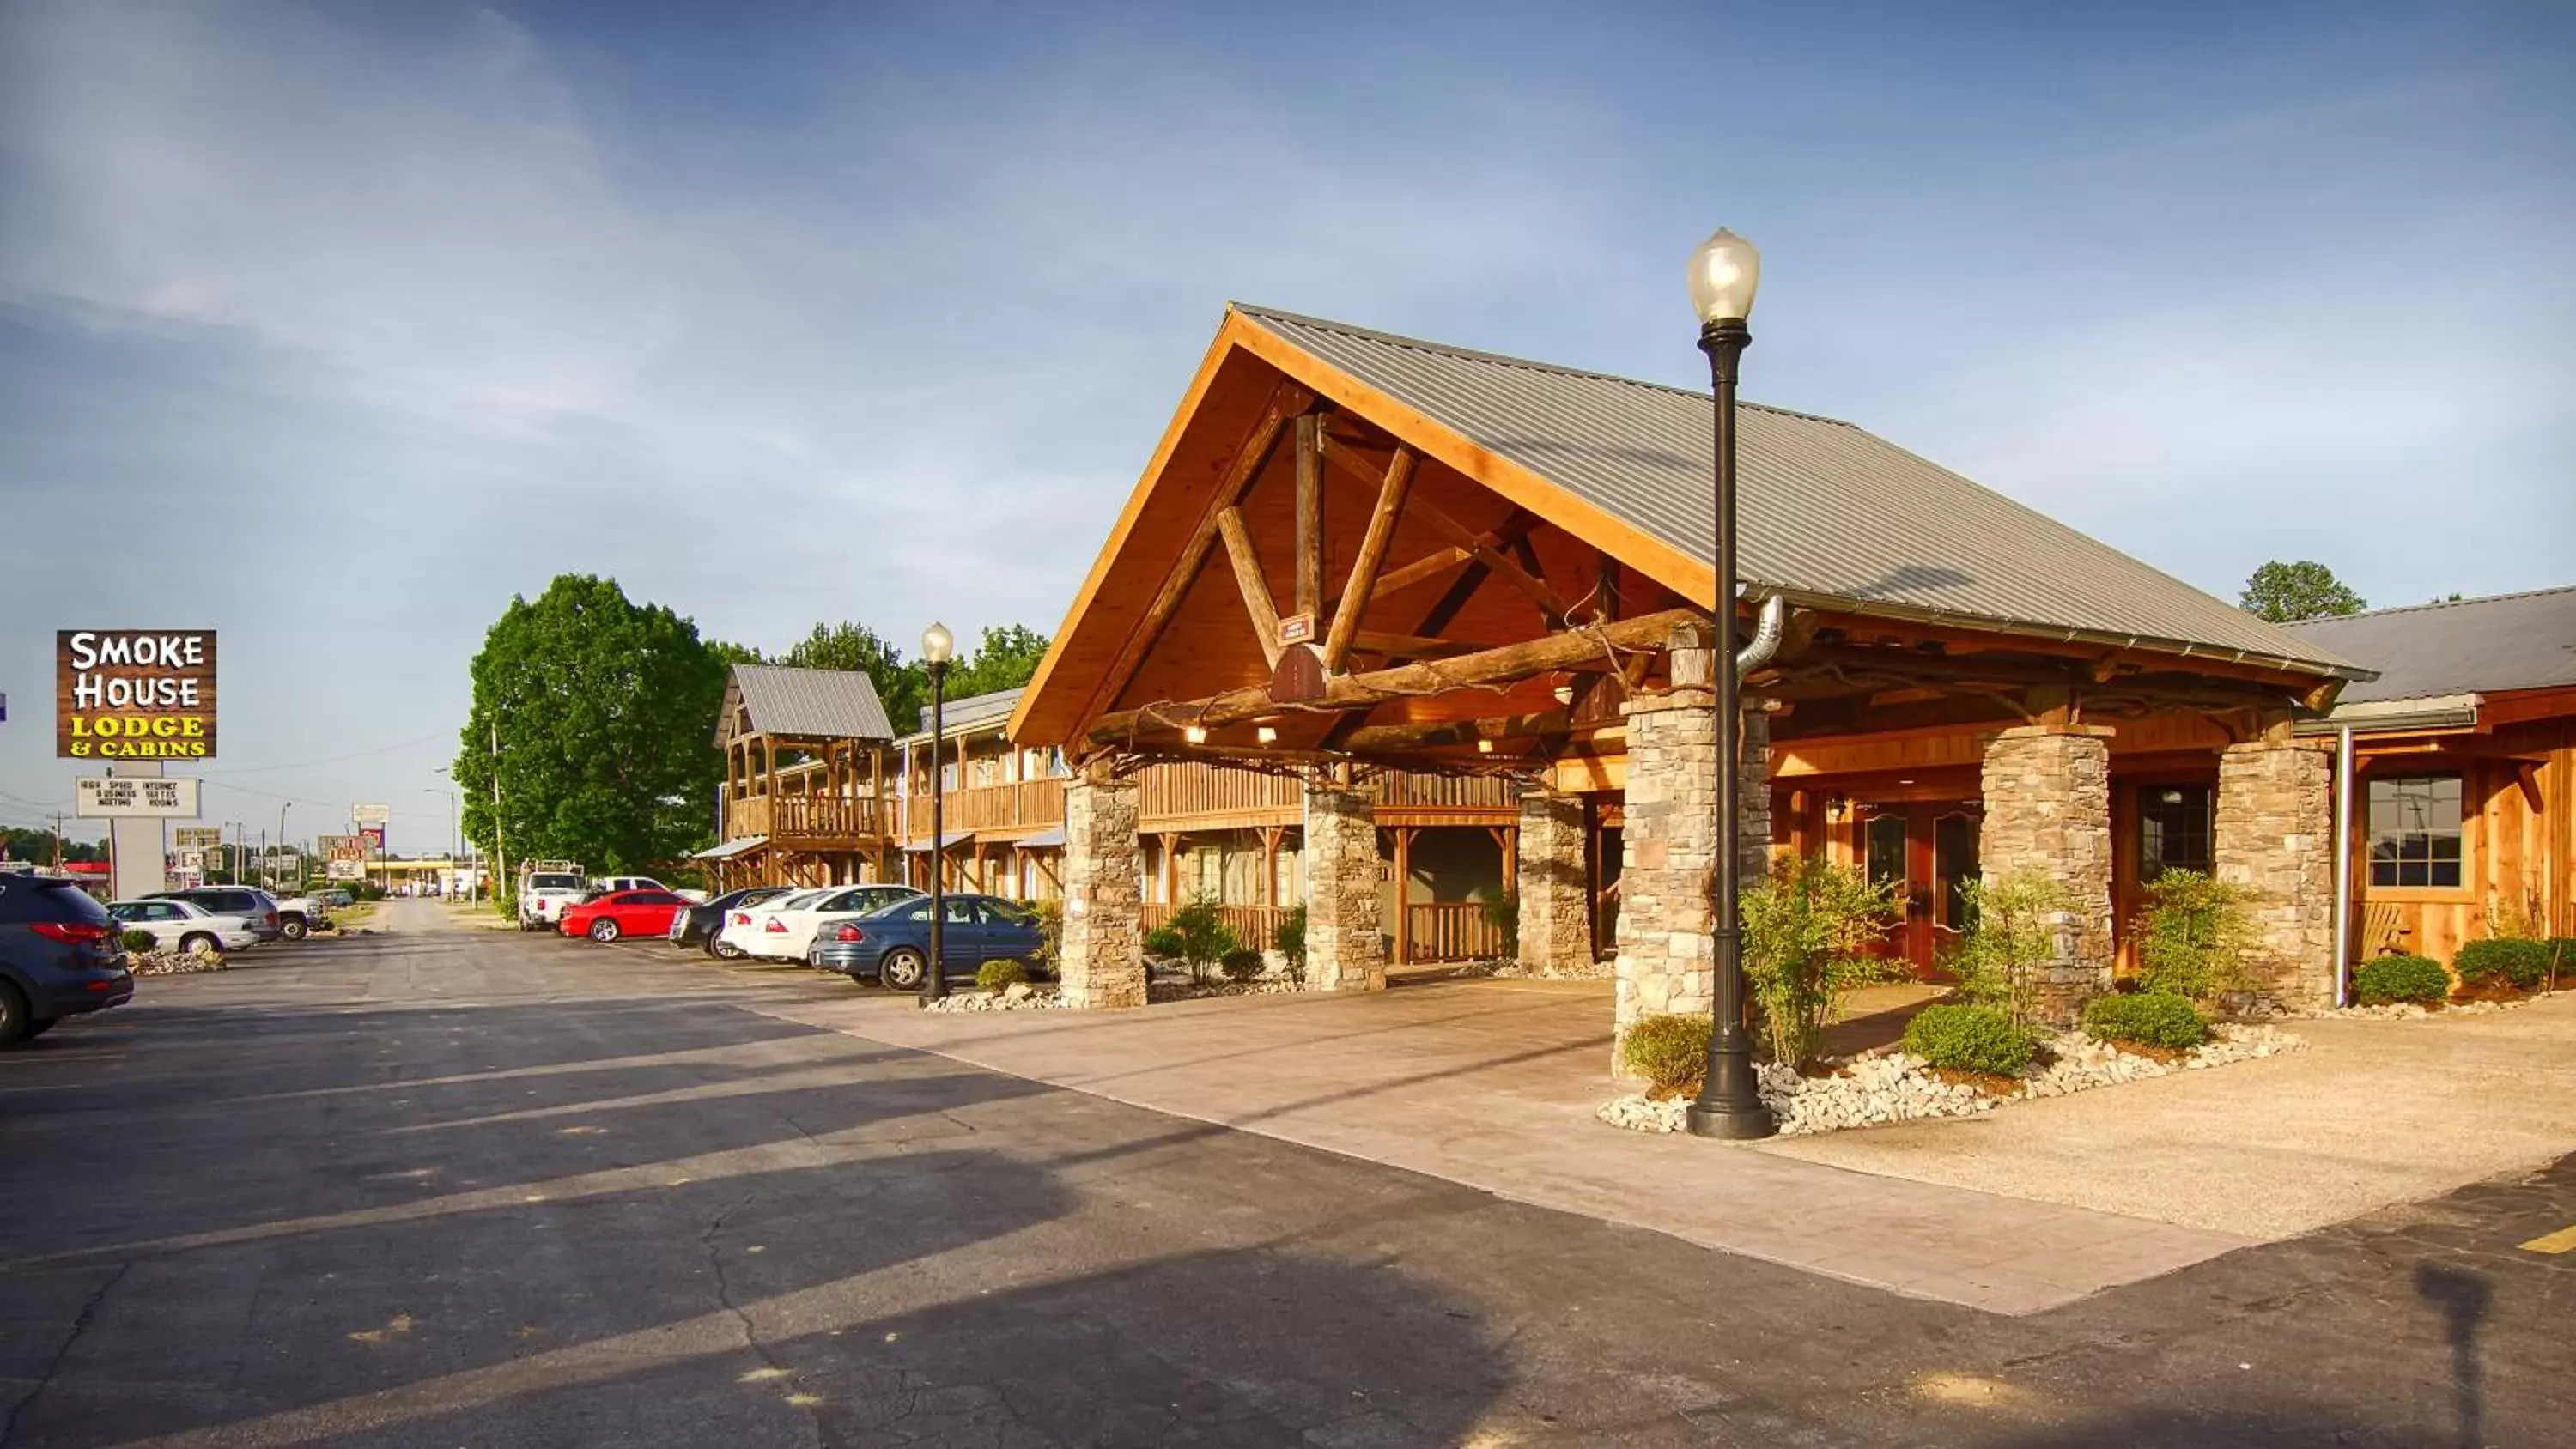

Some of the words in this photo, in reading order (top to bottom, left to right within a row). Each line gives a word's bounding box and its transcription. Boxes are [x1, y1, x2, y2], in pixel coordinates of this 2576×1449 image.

[71, 717, 204, 737] LODGE
[70, 742, 92, 756] &
[100, 741, 206, 756] CABINS
